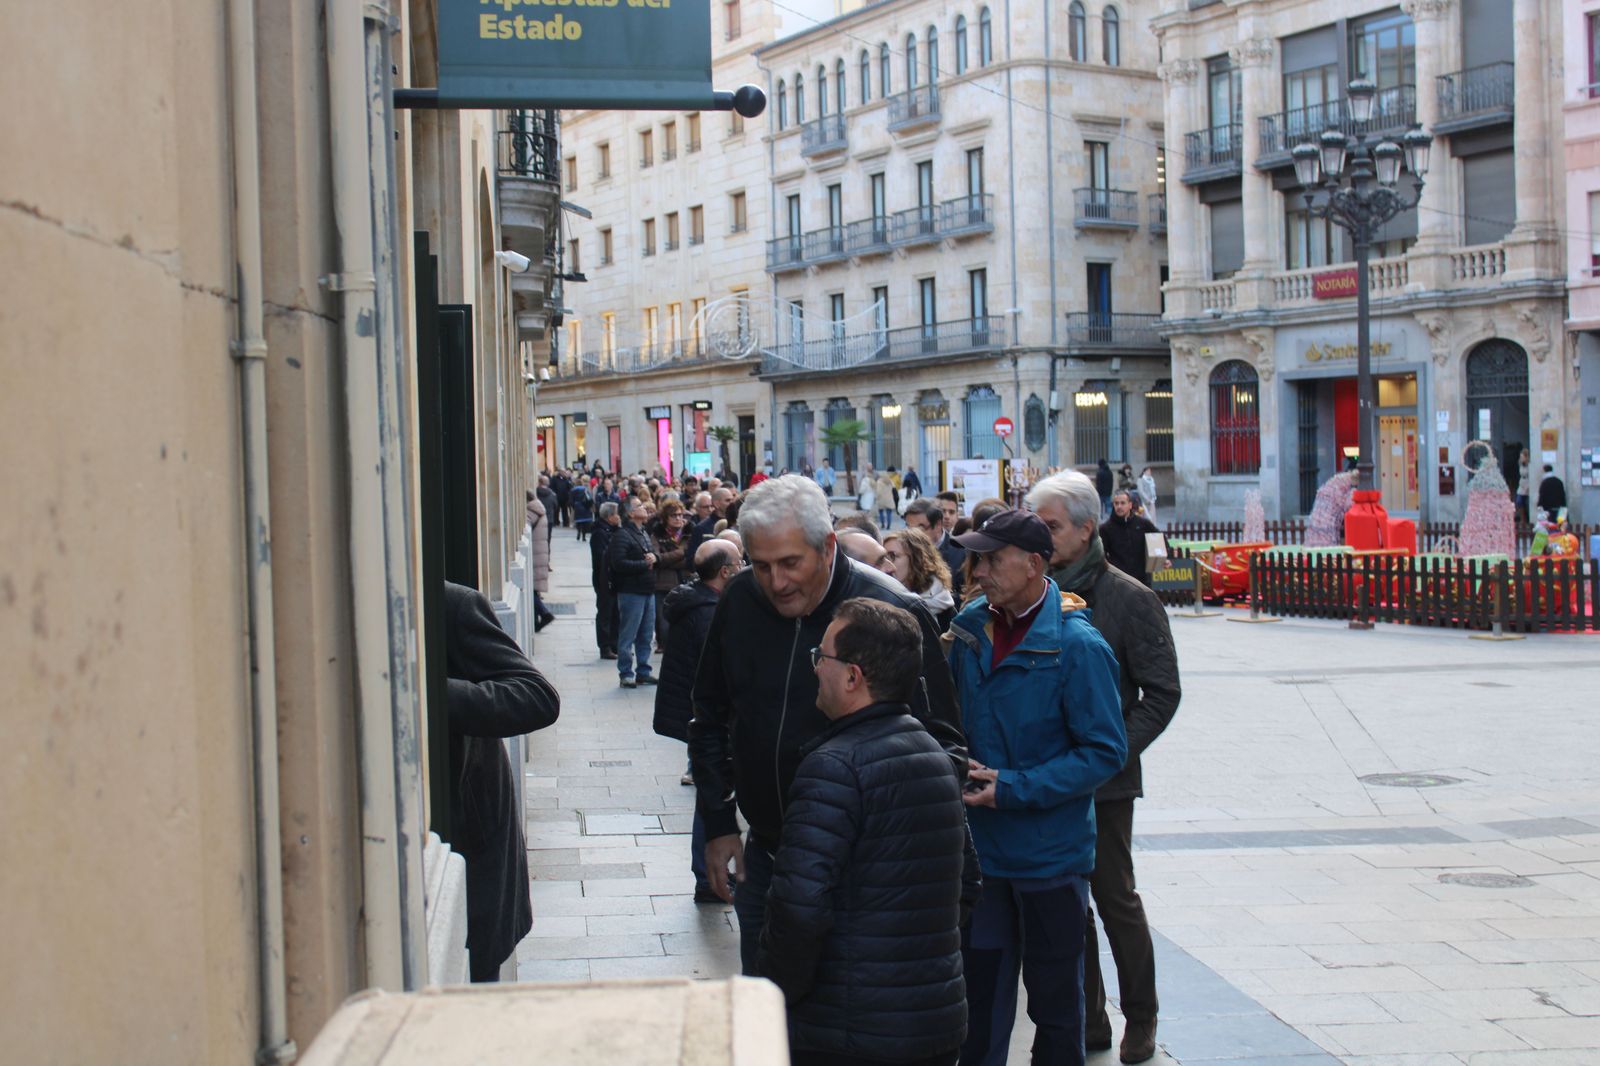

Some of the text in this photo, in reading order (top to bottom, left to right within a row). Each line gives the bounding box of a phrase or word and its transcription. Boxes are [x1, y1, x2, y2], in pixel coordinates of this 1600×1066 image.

[479, 13, 582, 40] Estado
[1316, 275, 1356, 292] NOTARÍA
[1323, 342, 1392, 360] Santader
[1075, 392, 1108, 407] BBVA
[1152, 567, 1193, 581] ENTRADA
